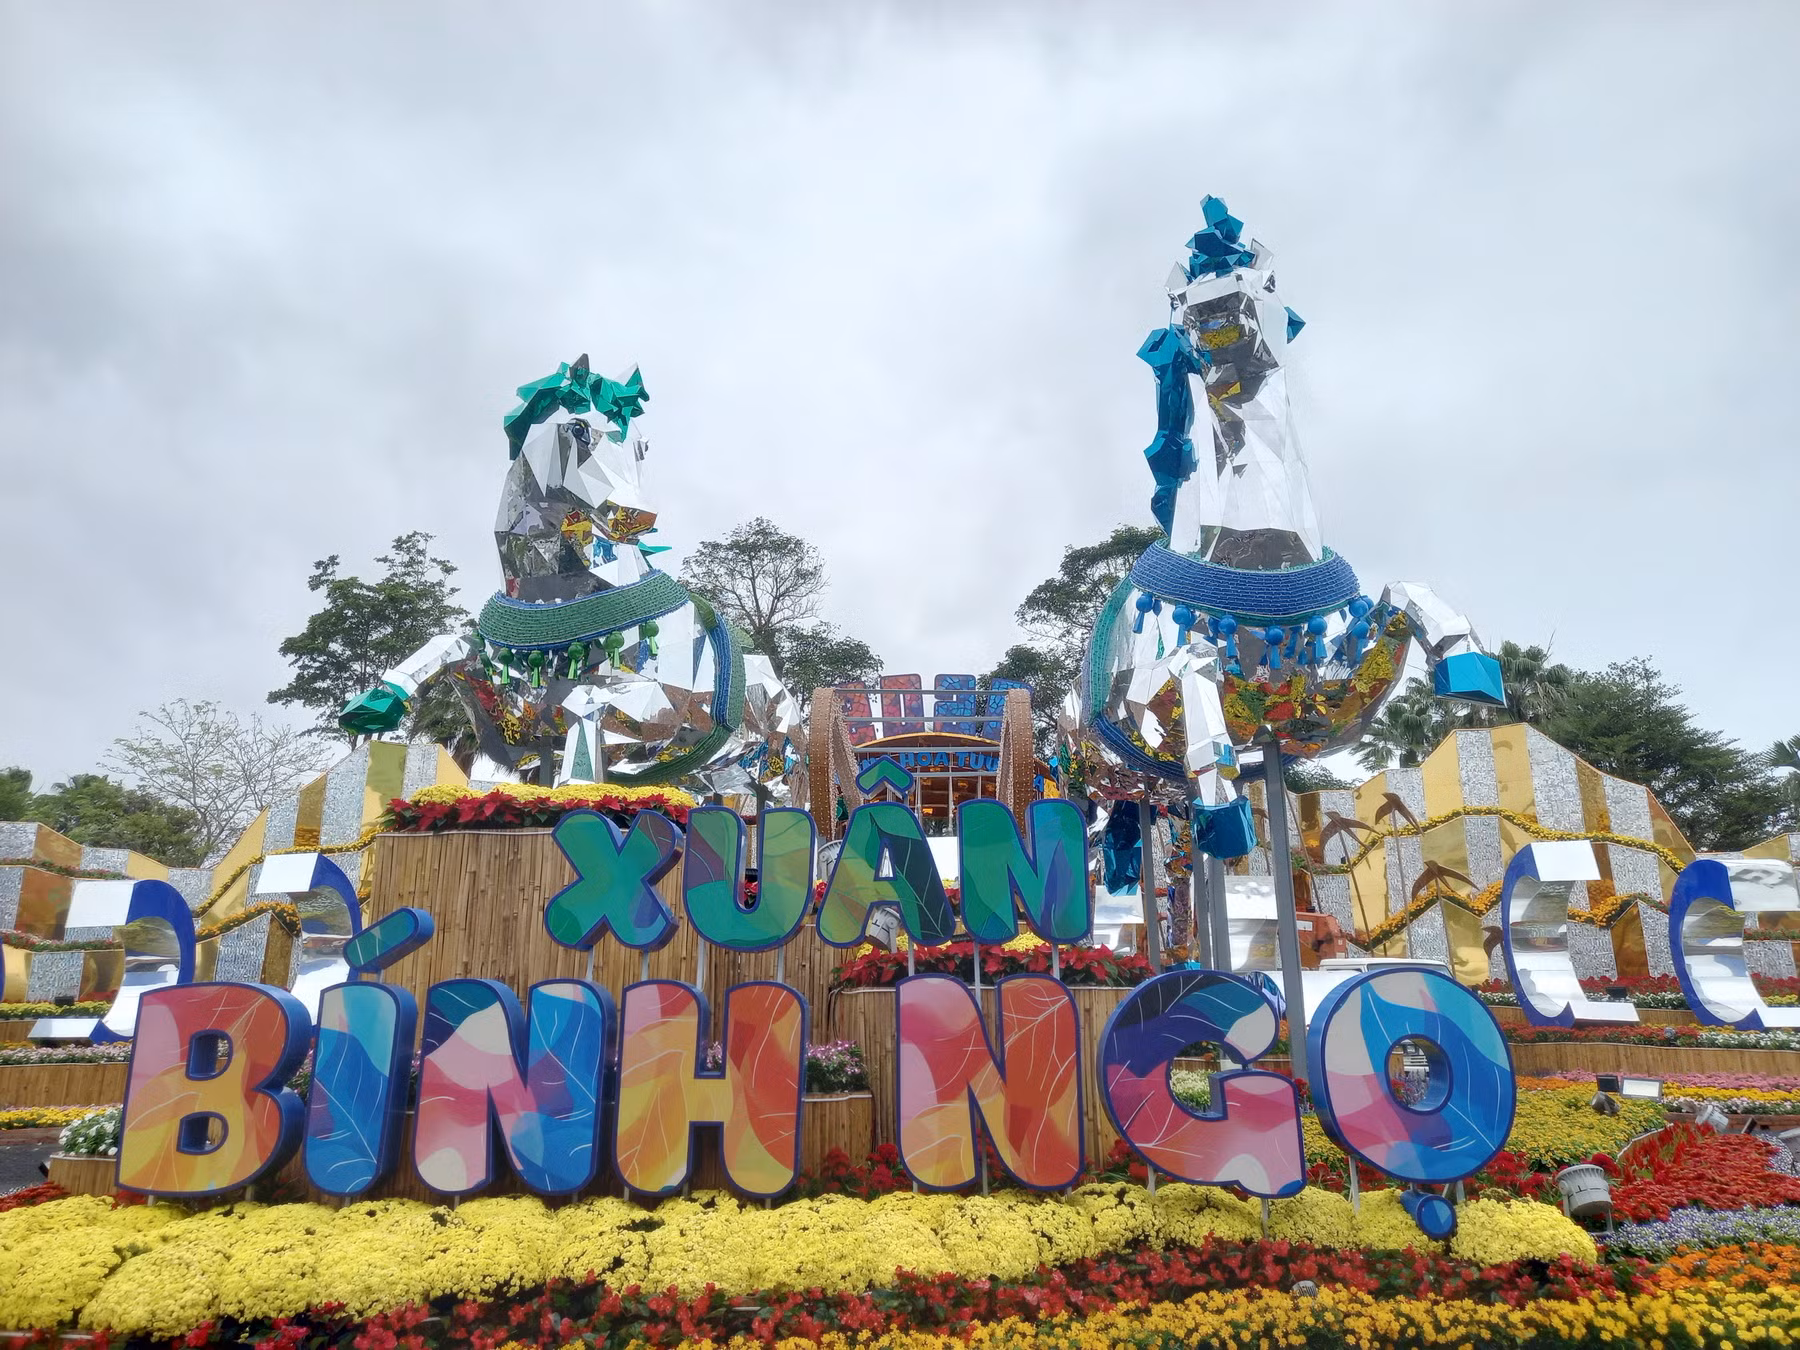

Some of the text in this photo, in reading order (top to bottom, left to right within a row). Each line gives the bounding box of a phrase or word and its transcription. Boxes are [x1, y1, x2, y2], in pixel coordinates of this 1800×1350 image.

[545, 756, 1090, 951] XUÂN
[115, 907, 1517, 1240] BÍNH NGỌ
